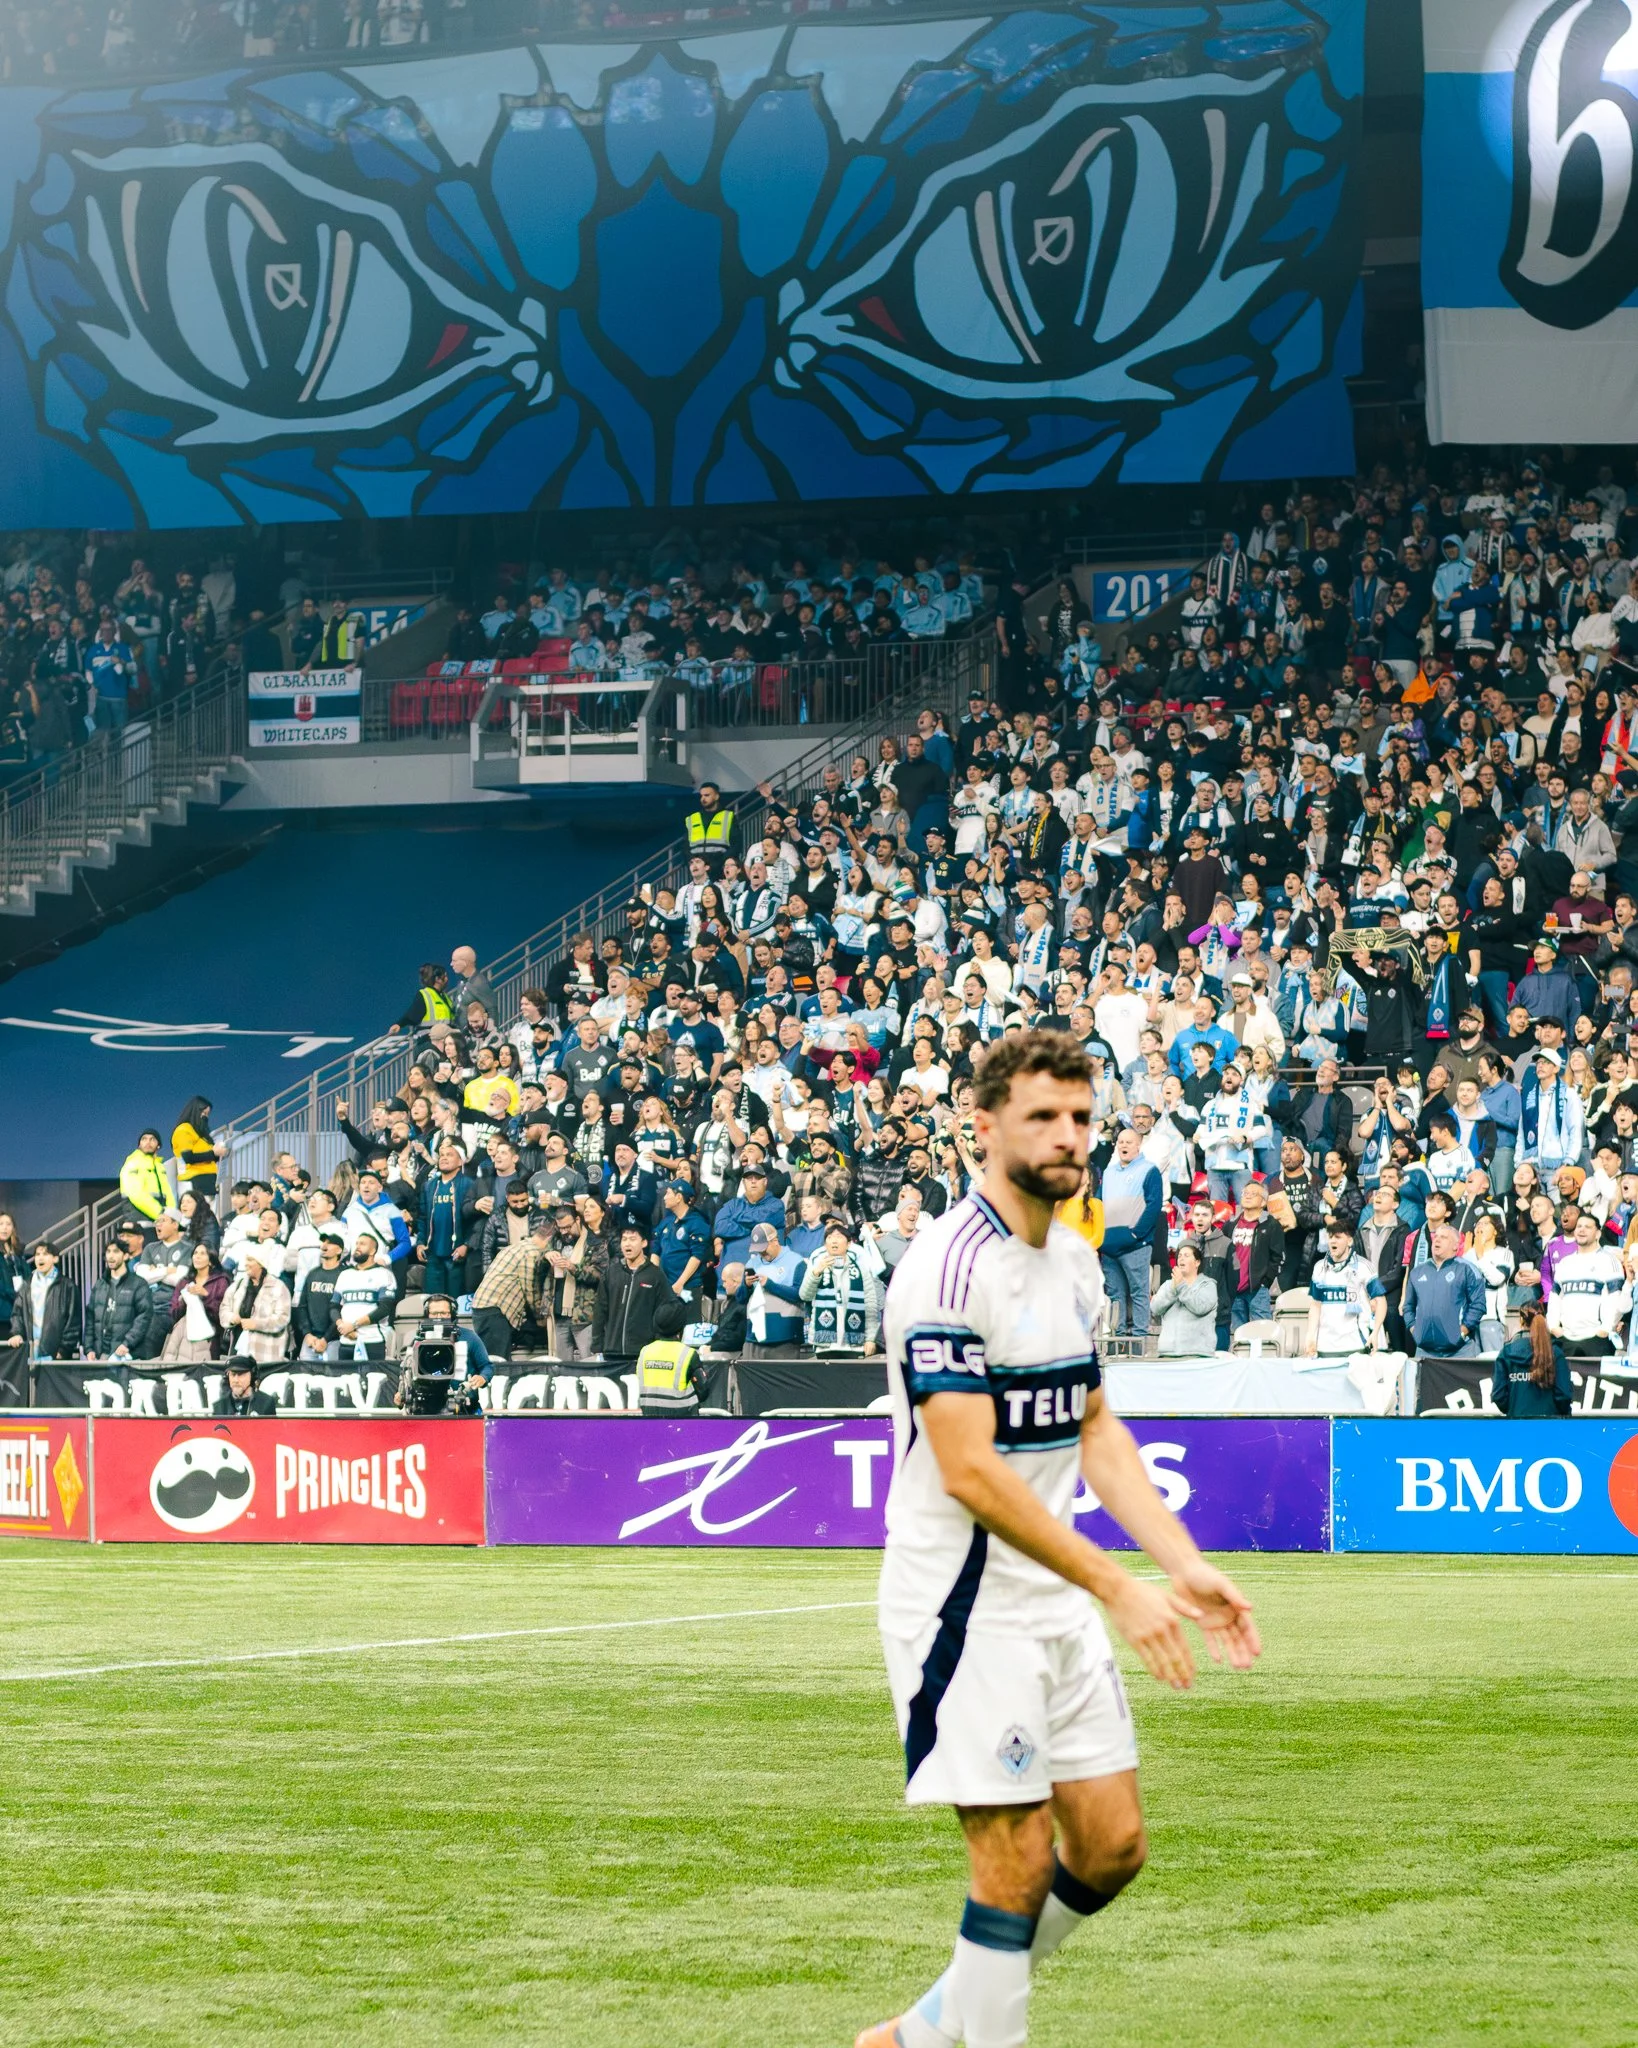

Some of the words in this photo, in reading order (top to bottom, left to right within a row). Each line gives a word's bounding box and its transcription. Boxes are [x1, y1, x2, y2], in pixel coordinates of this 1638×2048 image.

[1107, 573, 1169, 618] 201
[263, 673, 347, 689] GIBRALTAR
[263, 727, 347, 743] WHITECAPS
[579, 1068, 602, 1081] Bell
[311, 1281, 334, 1294] DIOR
[1323, 1291, 1346, 1301] ELU
[275, 1443, 427, 1519] PRINGLES
[1396, 1457, 1583, 1513] BMO
